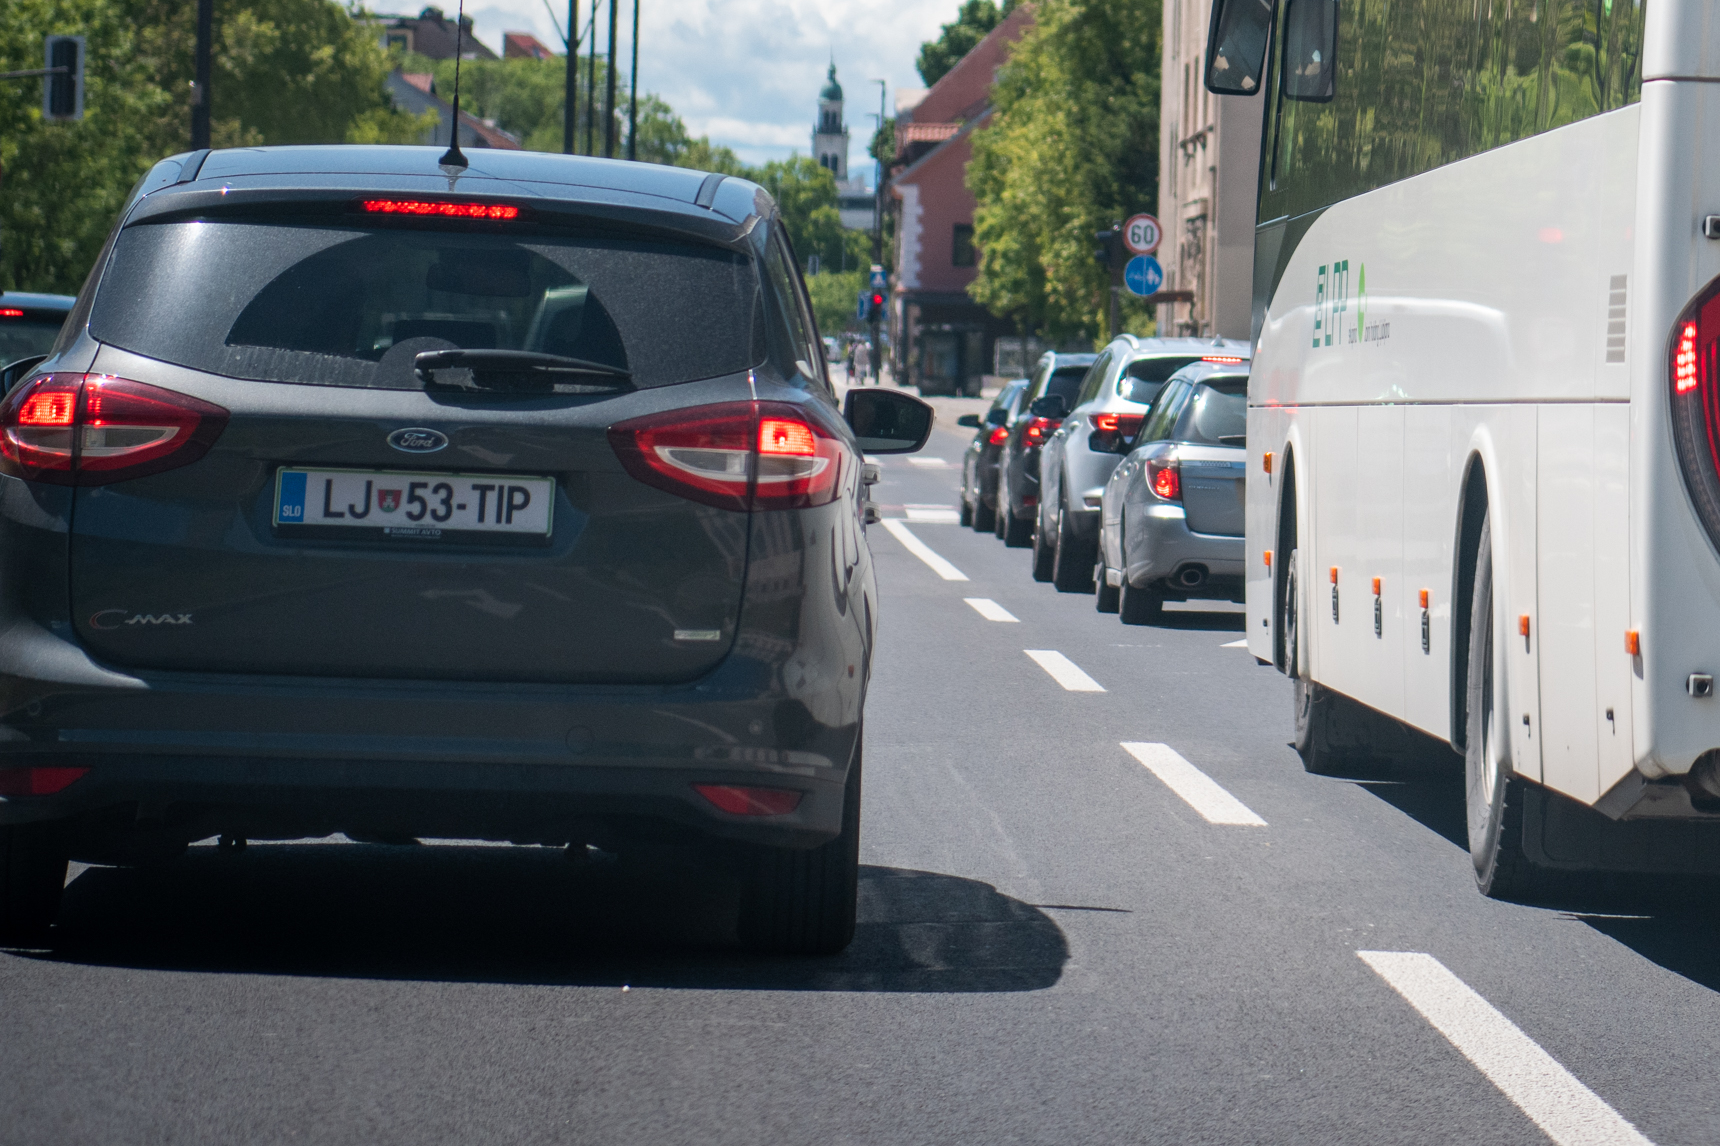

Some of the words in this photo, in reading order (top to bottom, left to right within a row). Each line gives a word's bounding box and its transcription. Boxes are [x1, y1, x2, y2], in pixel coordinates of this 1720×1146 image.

[1131, 224, 1155, 244] 60
[400, 432, 435, 449] Ford
[322, 478, 373, 520] LJ
[405, 481, 531, 525] 53-TIP
[282, 505, 301, 517] SLO
